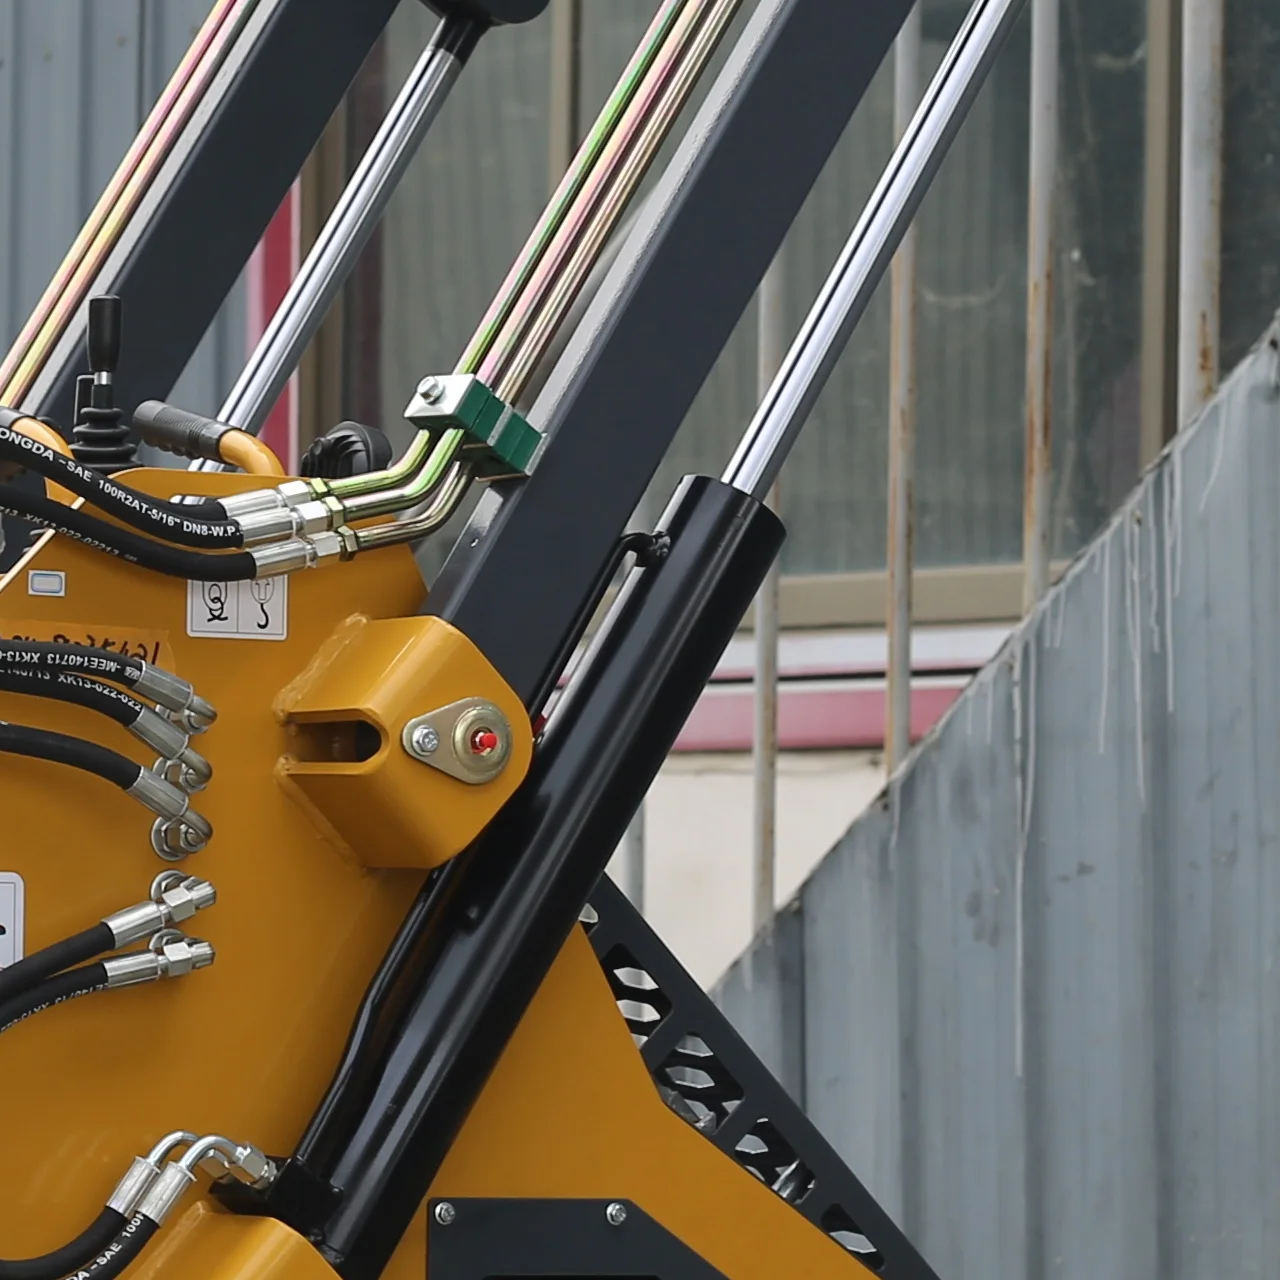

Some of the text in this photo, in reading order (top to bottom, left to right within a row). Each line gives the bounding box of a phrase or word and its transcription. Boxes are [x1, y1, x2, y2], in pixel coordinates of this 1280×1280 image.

[58, 458, 93, 482] -SAE
[98, 479, 181, 527] 100R2AT-5/16"
[90, 1242, 123, 1270] -SAE
